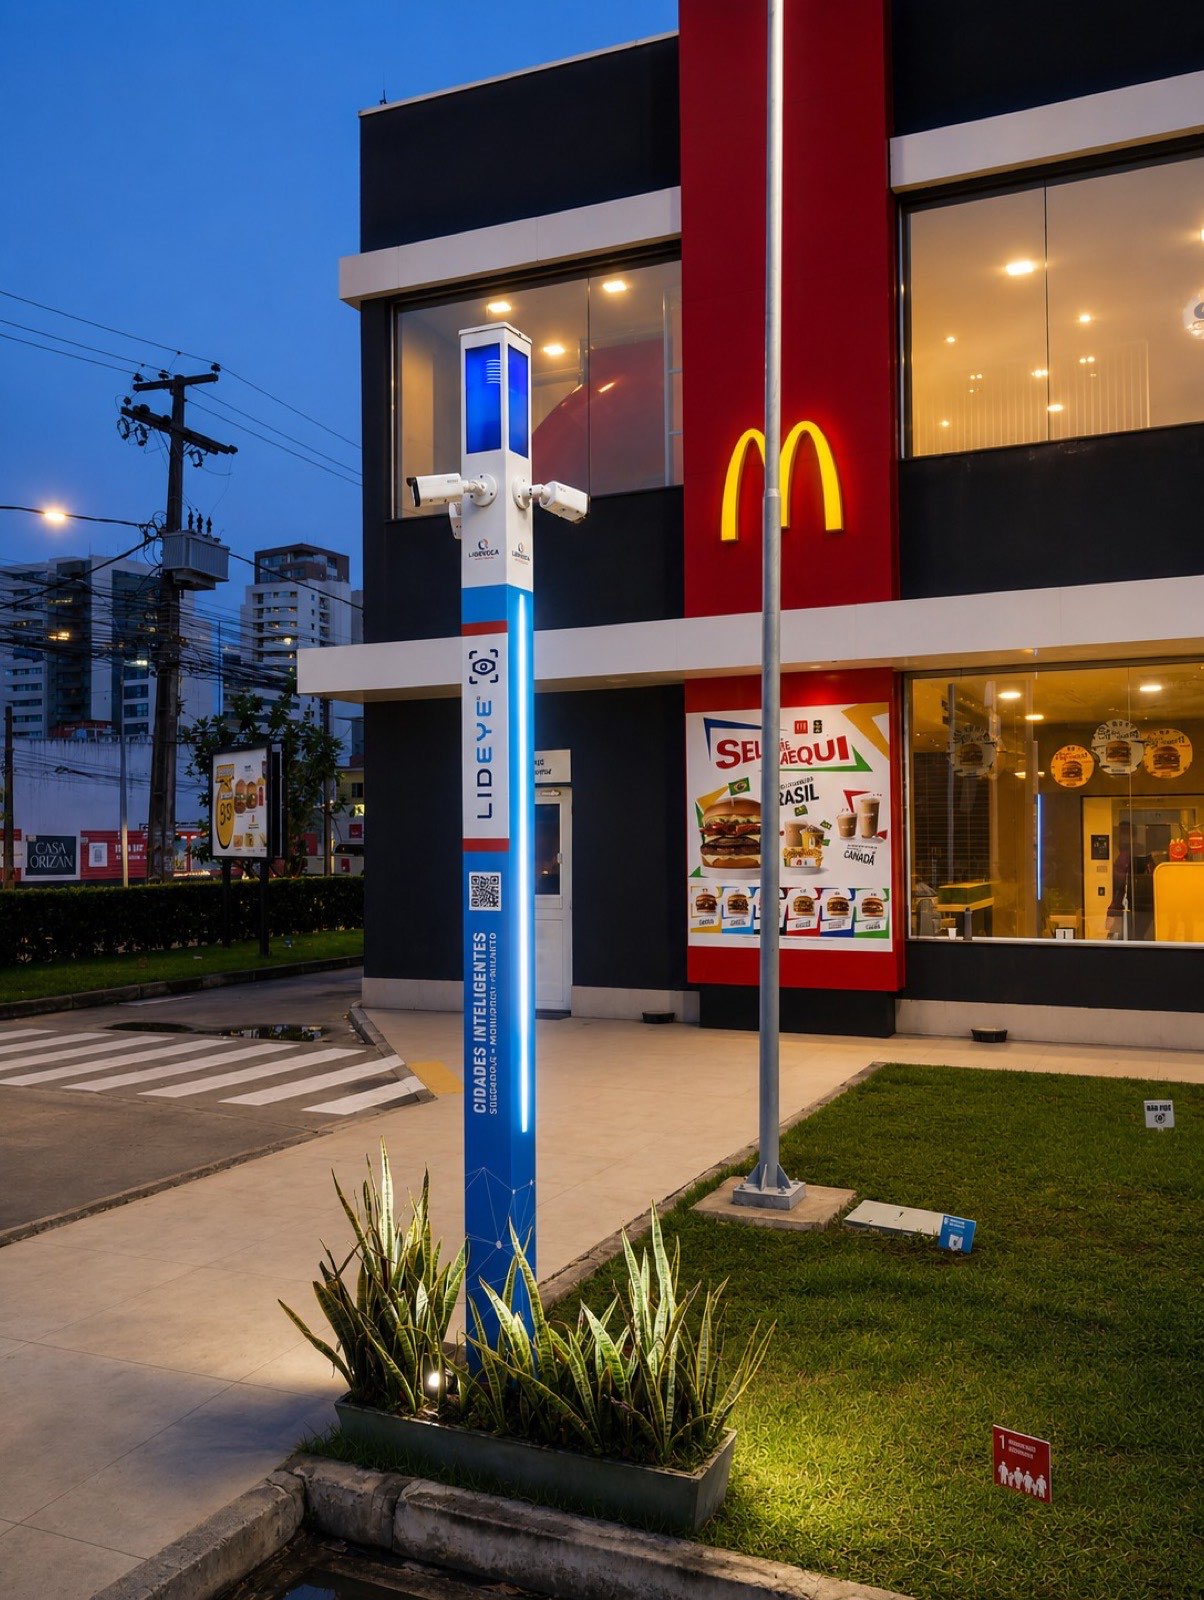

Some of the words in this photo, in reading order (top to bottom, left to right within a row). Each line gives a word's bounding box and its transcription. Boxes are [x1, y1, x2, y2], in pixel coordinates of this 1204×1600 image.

[477, 700, 493, 819] LIDEYE
[779, 783, 820, 806] RASIL
[35, 842, 67, 855] CASA
[473, 932, 487, 1042] INTELIGENTES
[473, 1047, 487, 1114] CIDADES
